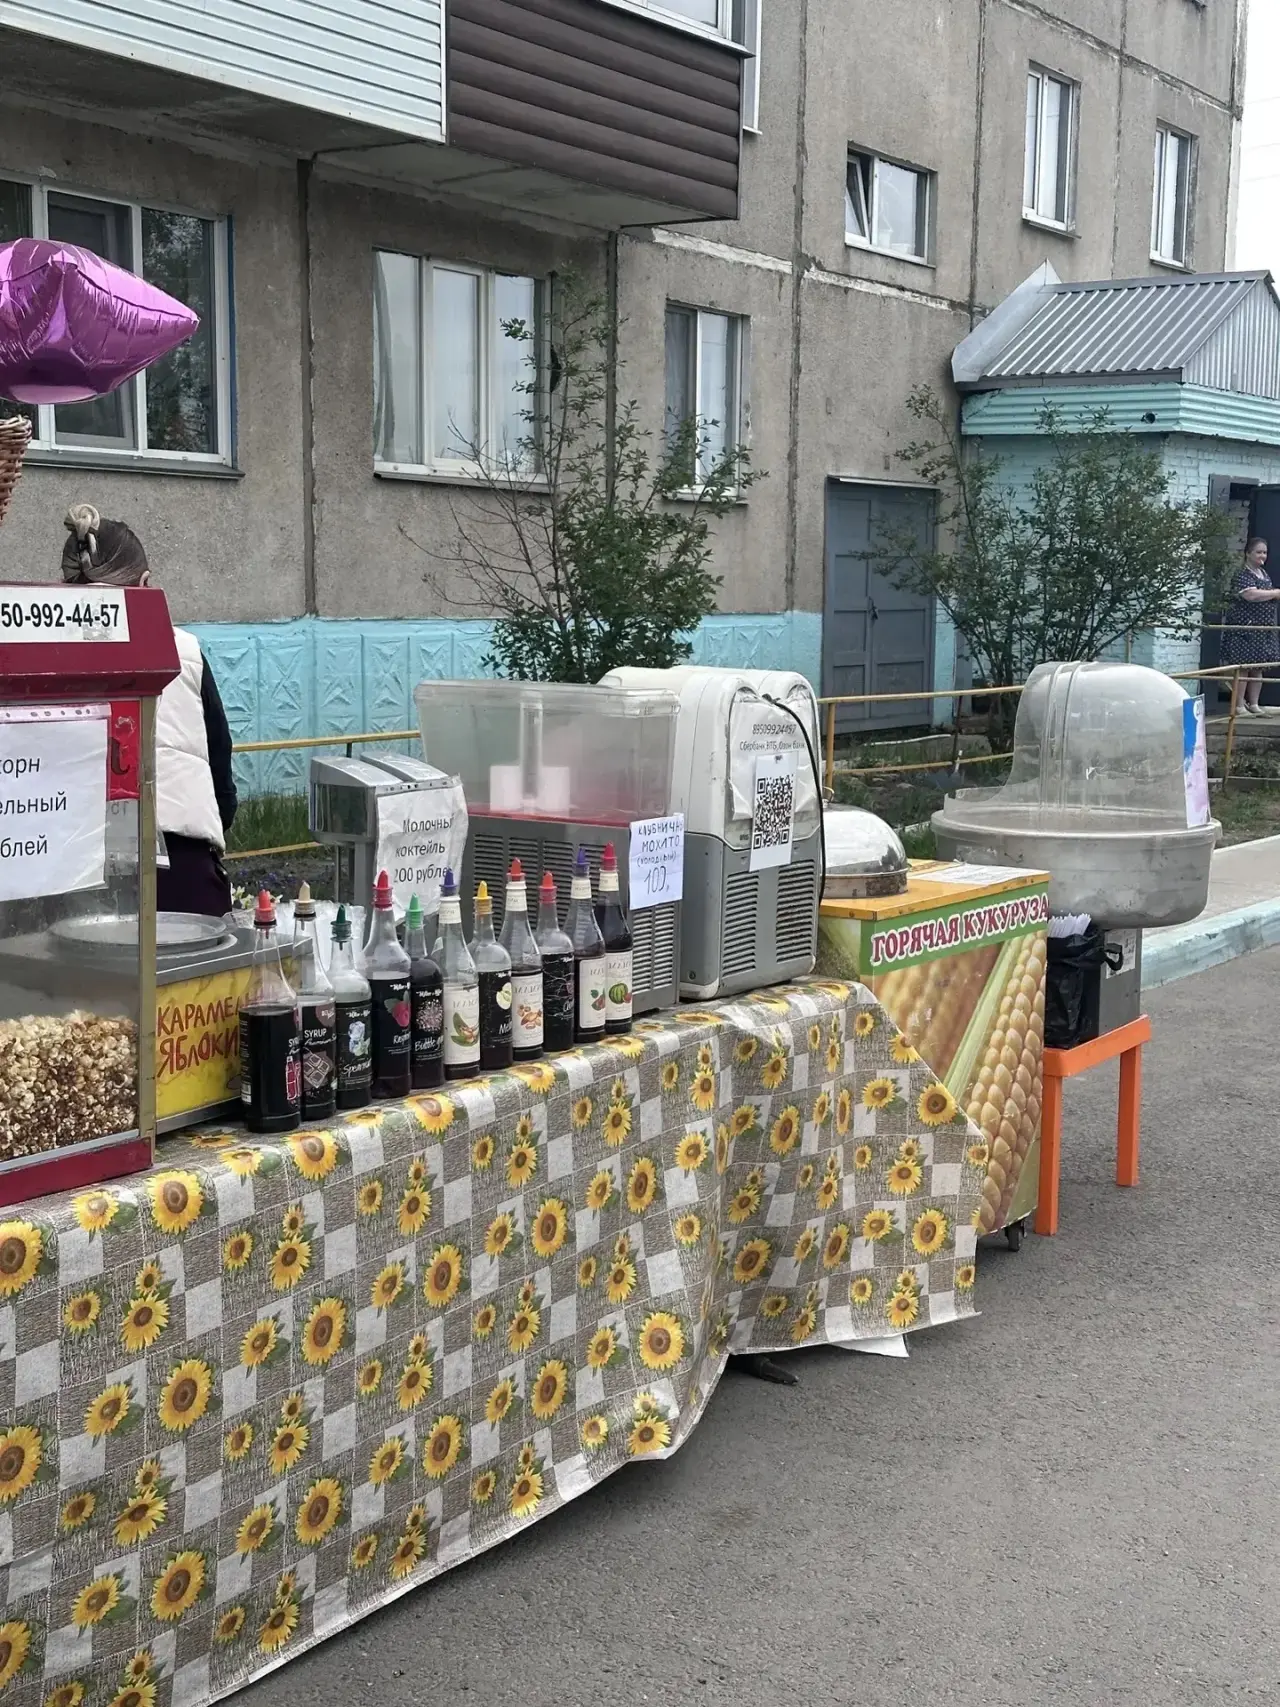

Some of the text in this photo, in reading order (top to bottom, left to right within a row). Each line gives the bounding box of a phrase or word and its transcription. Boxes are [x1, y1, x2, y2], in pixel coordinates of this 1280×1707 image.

[1, 603, 120, 628] 50-992-44-57
[0, 757, 41, 778] орн
[0, 790, 68, 815] льный
[403, 814, 454, 832] Молочны
[395, 840, 446, 858] коктейль
[416, 864, 450, 884] рубле
[872, 894, 1049, 963] ГОРЯЧАЯ КУКУРУЗА
[304, 1028, 327, 1038] SYRUP
